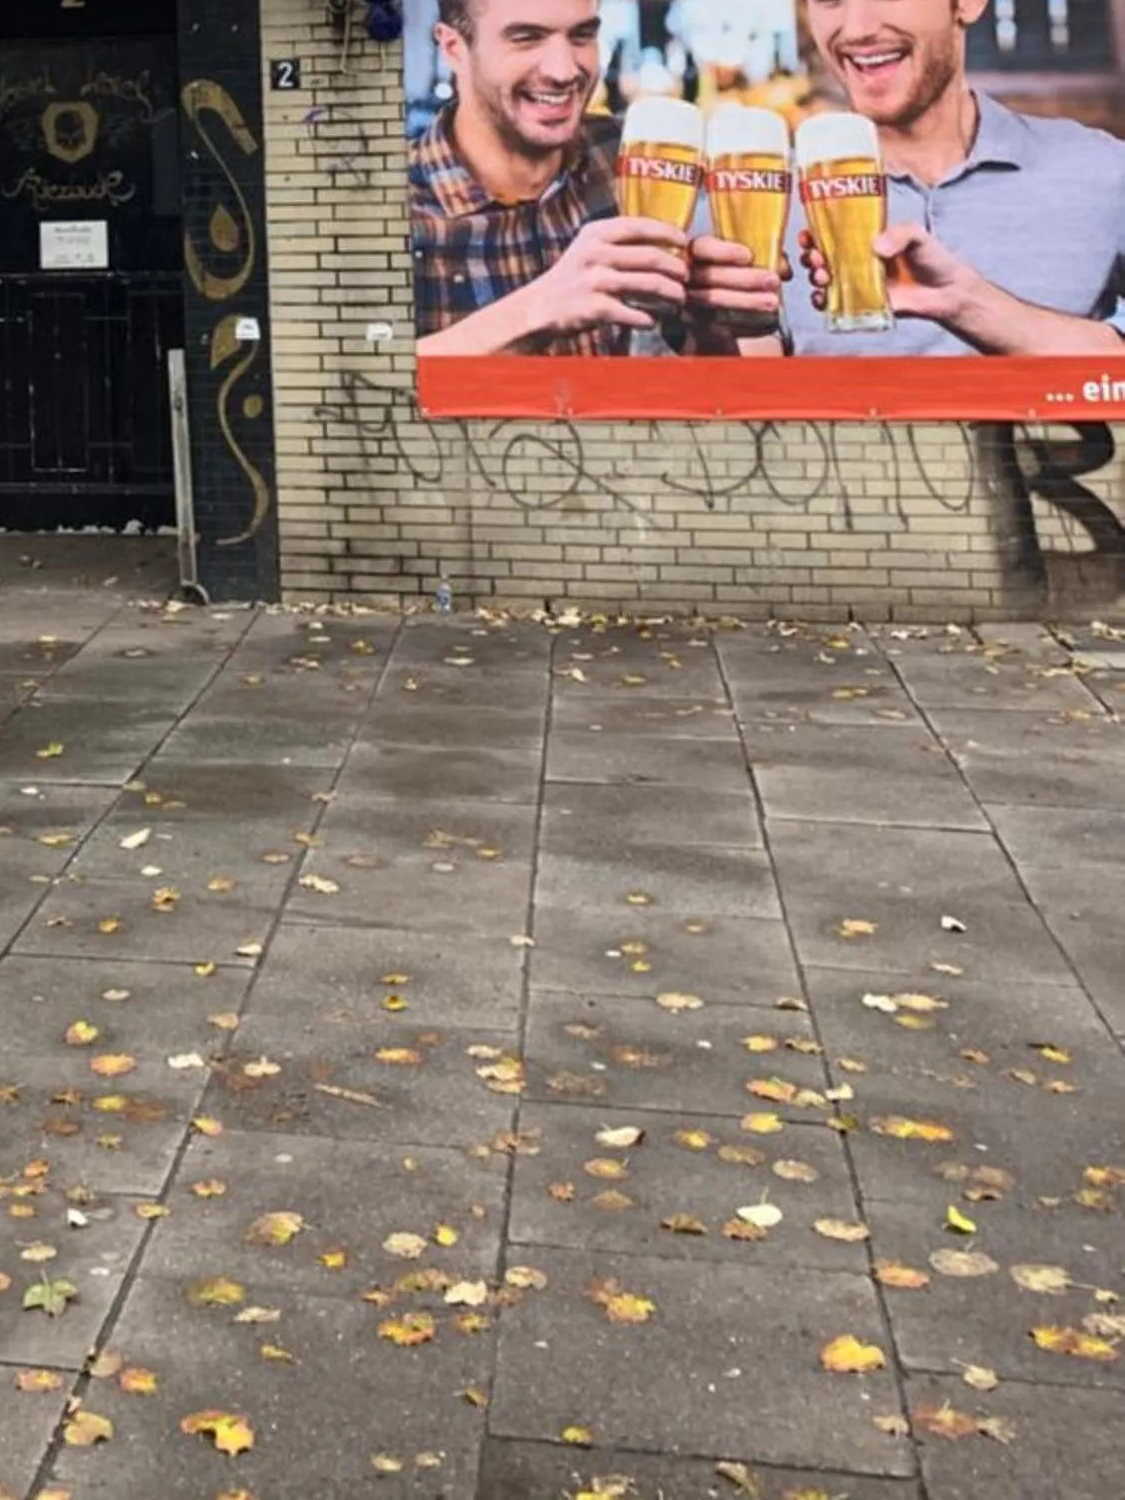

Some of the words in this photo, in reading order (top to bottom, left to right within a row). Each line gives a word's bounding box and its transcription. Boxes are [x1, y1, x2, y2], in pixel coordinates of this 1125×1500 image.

[277, 60, 295, 88] 2
[627, 156, 695, 184] TYSKIE
[714, 170, 784, 191] TYSKIE
[809, 176, 881, 199] TYSKIE
